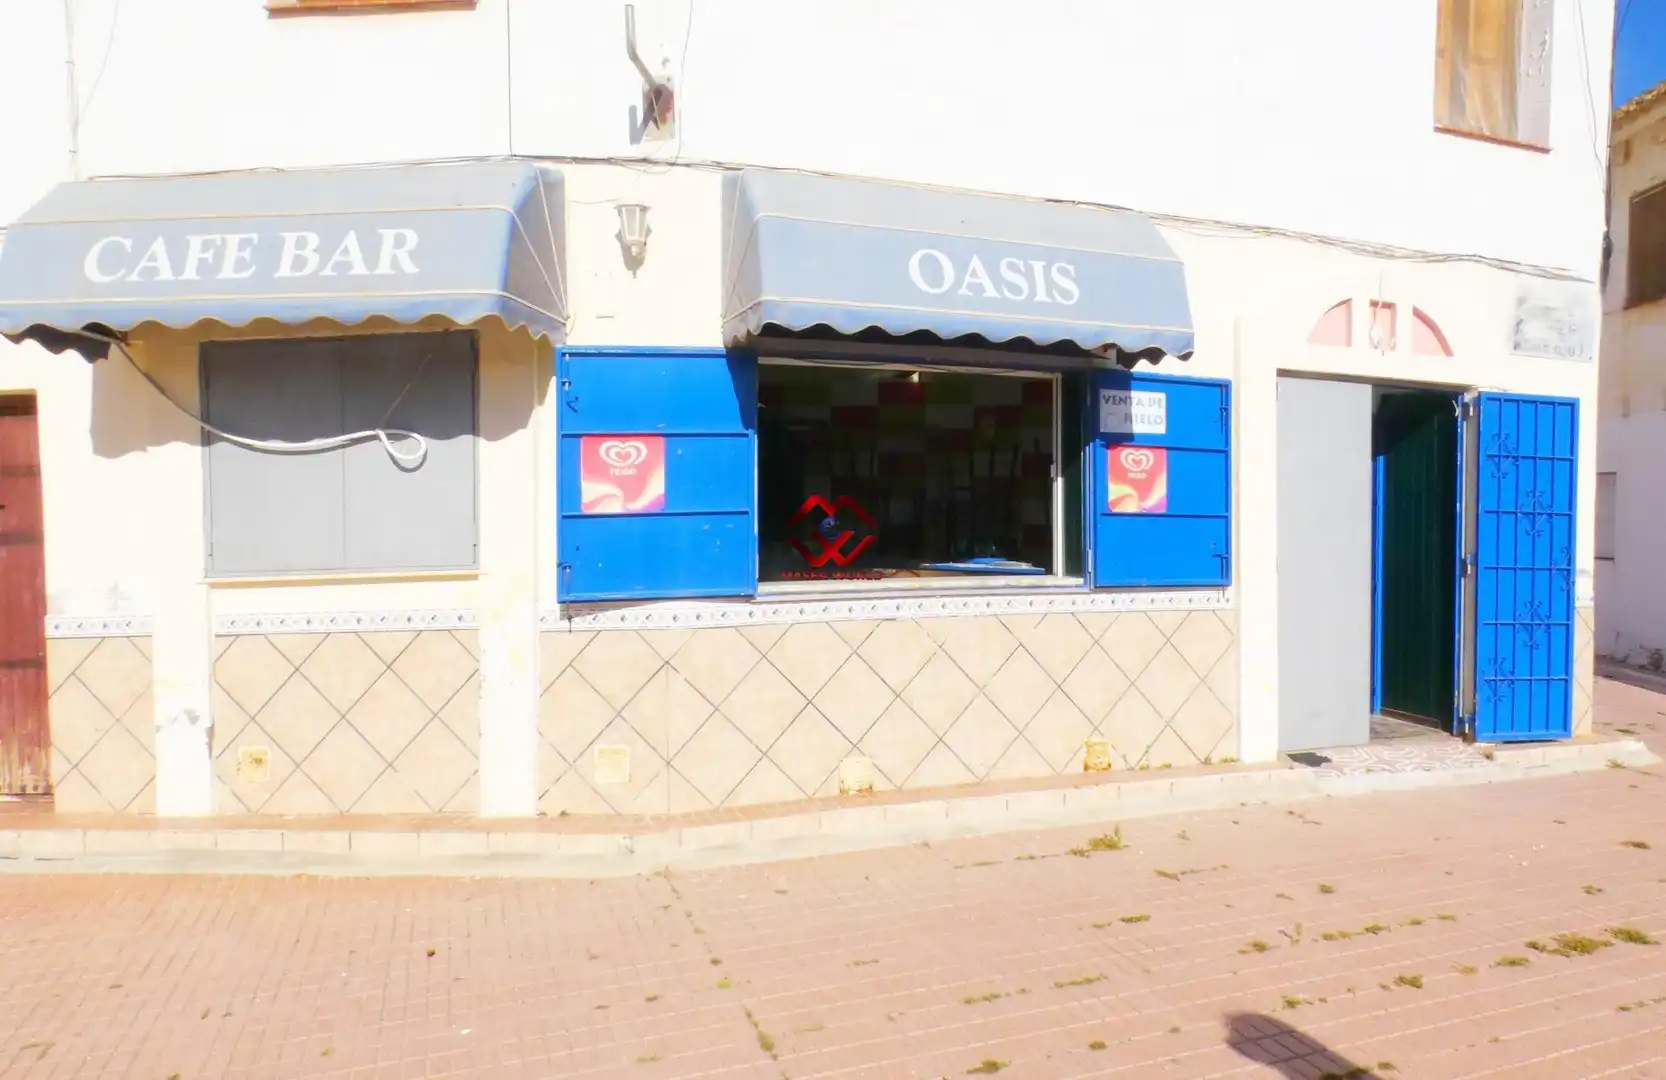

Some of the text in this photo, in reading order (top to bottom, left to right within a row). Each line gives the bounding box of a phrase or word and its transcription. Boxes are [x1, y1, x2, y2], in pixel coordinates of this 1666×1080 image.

[83, 227, 421, 284] CAFE BAR
[908, 248, 1081, 306] OASIS
[1102, 394, 1165, 410] VENTA DE
